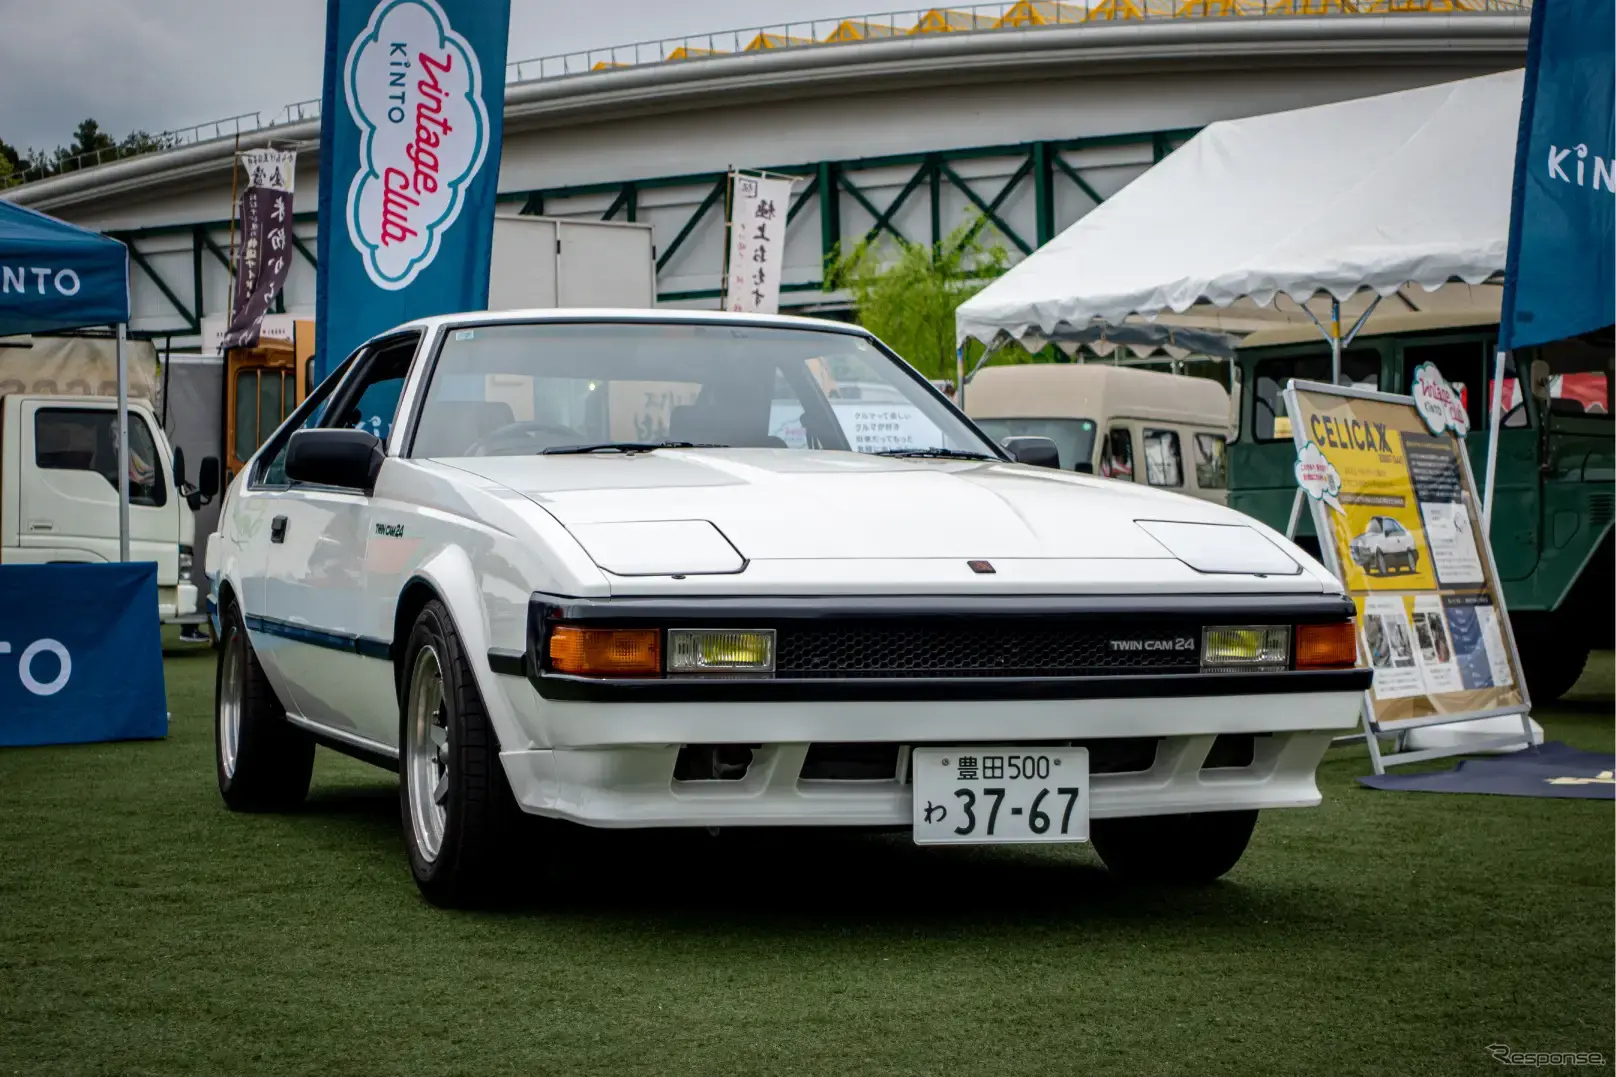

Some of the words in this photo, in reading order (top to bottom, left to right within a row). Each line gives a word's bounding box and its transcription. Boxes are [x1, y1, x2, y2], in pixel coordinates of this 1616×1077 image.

[405, 51, 453, 196] Vintage
[380, 166, 421, 247] Club
[2, 265, 81, 296] NTO
[0, 638, 72, 696] O
[1110, 640, 1143, 650] TWIN
[1144, 640, 1173, 650] CAM
[1175, 638, 1195, 650] 24
[924, 800, 947, 824] わ
[954, 787, 1079, 835] 37-67
